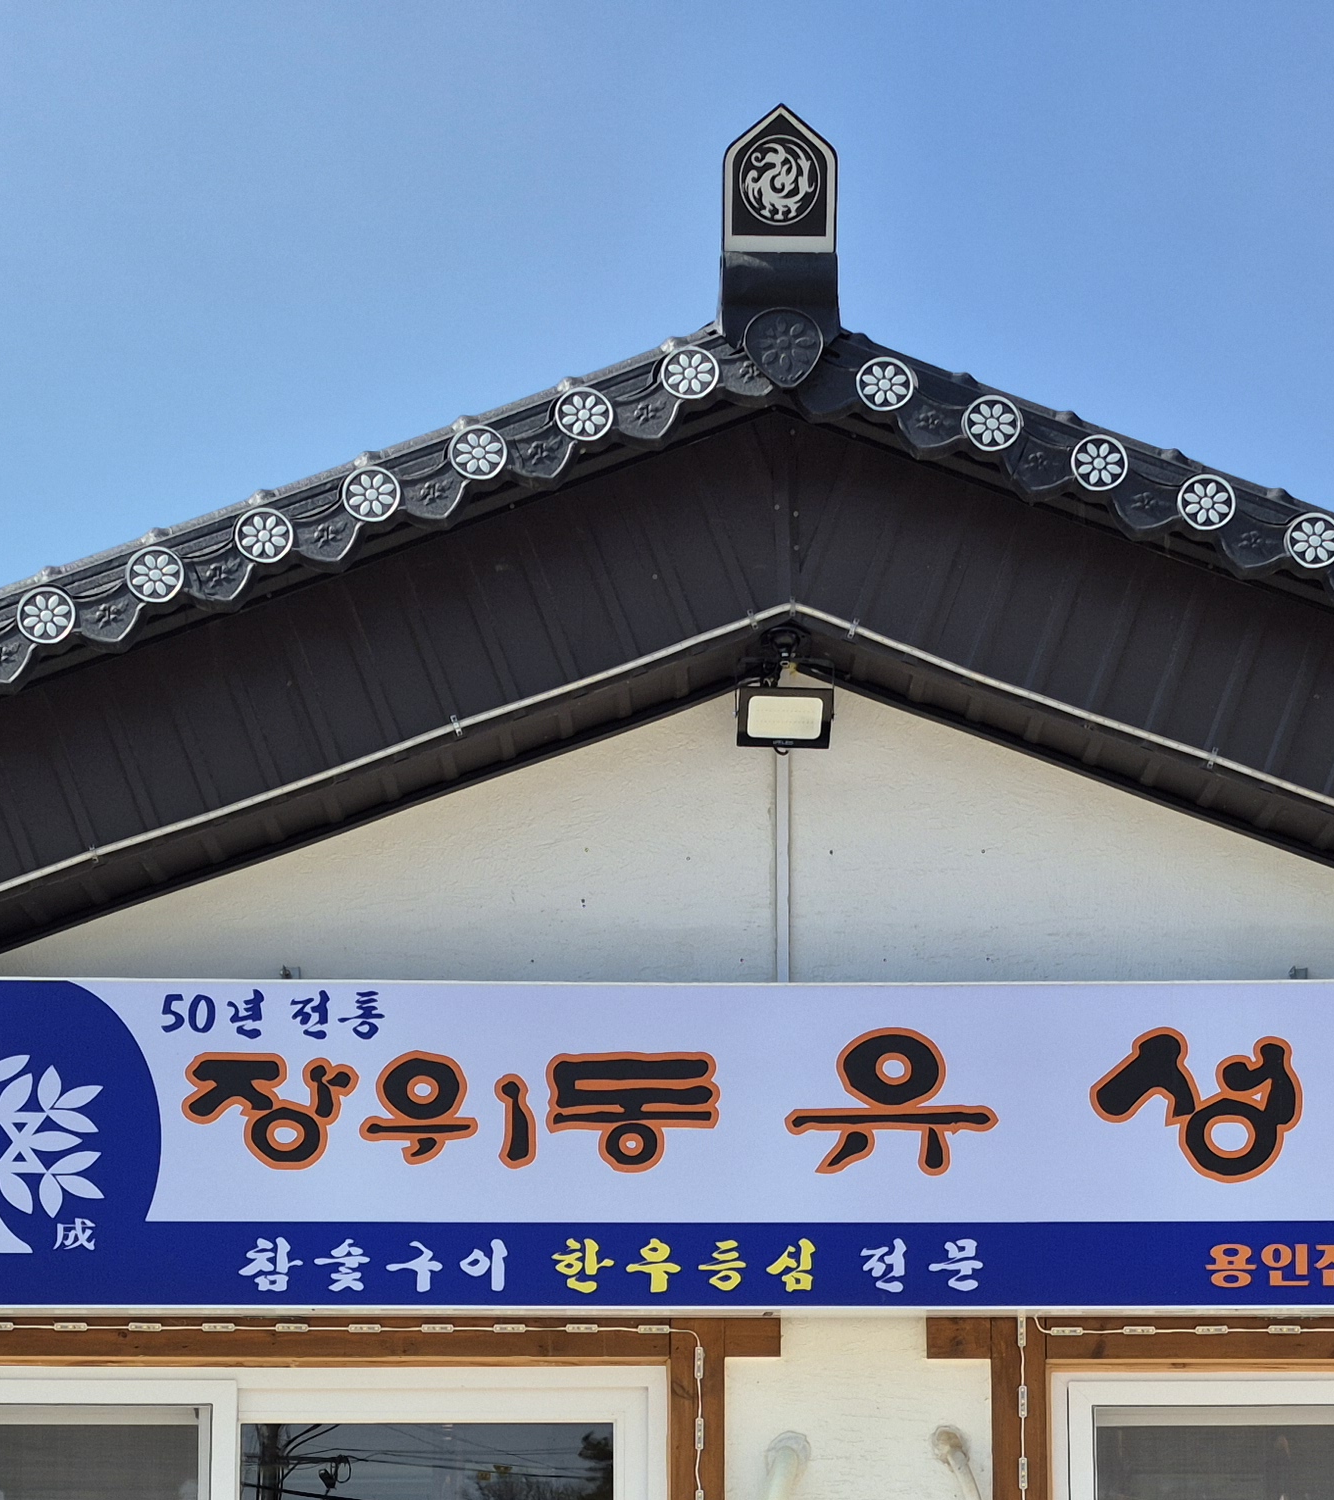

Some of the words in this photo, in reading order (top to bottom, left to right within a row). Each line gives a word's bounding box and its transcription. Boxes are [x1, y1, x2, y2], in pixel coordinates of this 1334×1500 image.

[161, 989, 265, 1040] 50년
[290, 990, 385, 1041] 전통
[182, 1050, 721, 1171] 장위동
[53, 1217, 96, 1251] 成
[238, 1236, 508, 1293] 참숯구이
[552, 1238, 816, 1293] 한우등심
[861, 1238, 984, 1293] 전문
